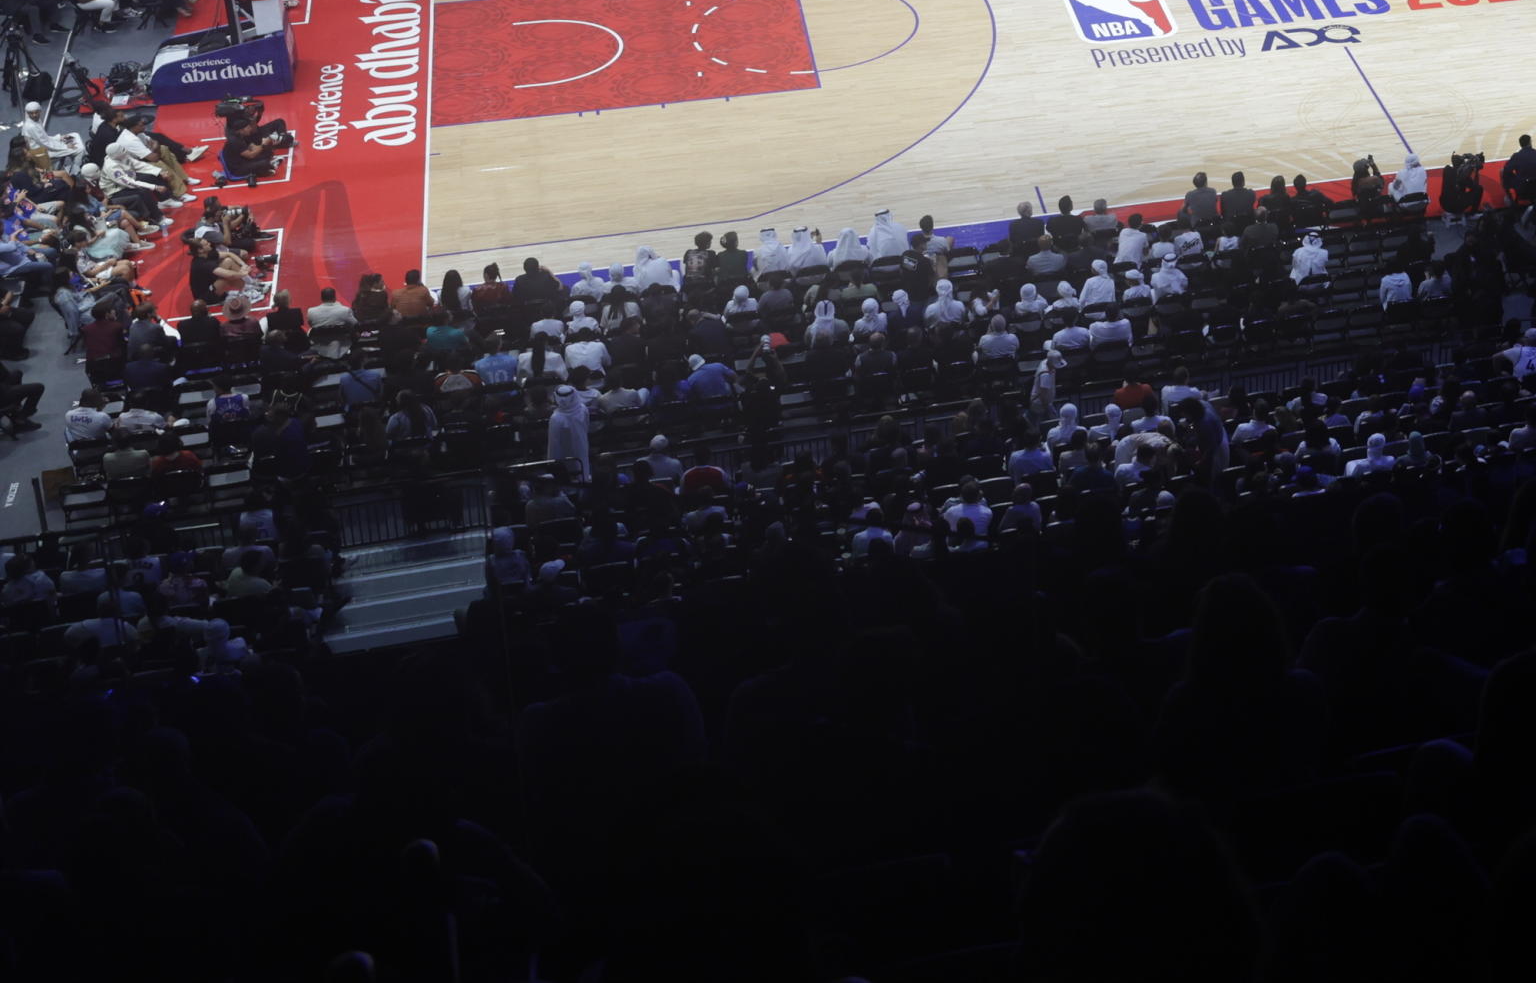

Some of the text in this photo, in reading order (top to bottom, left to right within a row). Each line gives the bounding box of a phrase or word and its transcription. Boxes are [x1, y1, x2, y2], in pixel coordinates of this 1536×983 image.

[1091, 18, 1141, 39] NBA
[1090, 24, 1363, 69] Presented by ADQ
[181, 58, 231, 70] experience
[181, 60, 274, 84] abu dhabi
[312, 63, 345, 150] experience
[349, 82, 418, 147] abu
